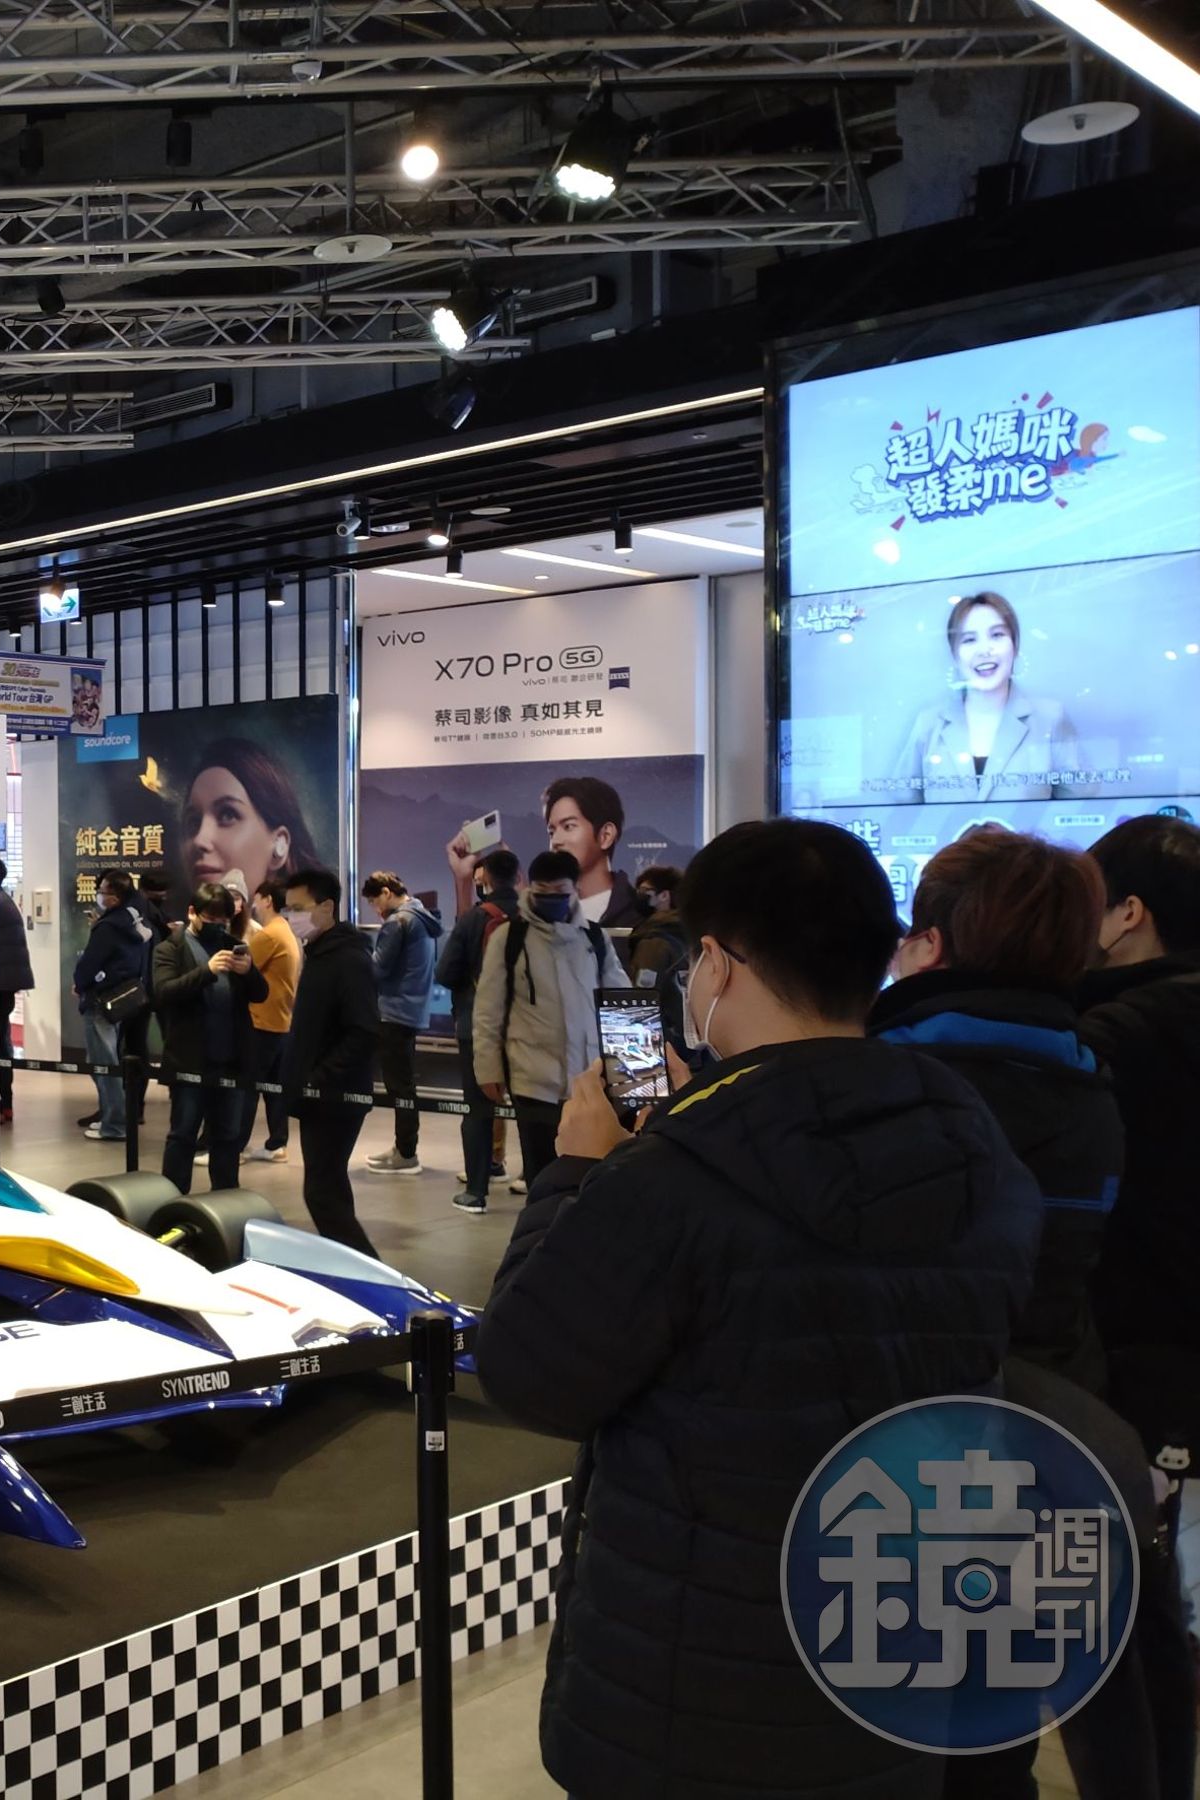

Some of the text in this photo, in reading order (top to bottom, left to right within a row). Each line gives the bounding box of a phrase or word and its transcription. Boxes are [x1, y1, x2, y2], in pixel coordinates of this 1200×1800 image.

[885, 405, 1079, 481] 超人媽咪
[377, 629, 425, 648] vivo
[435, 651, 596, 682] X70 Pro 5G
[522, 678, 546, 686] vivo
[13, 692, 28, 702] Tour
[435, 699, 604, 727] 蔡司影像 真如其見
[84, 733, 131, 748] soundcore
[75, 824, 164, 856] 純金音質
[280, 1355, 321, 1379] 三創生活
[162, 1370, 230, 1398] SYNTREND
[60, 1391, 106, 1417] 三創生活
